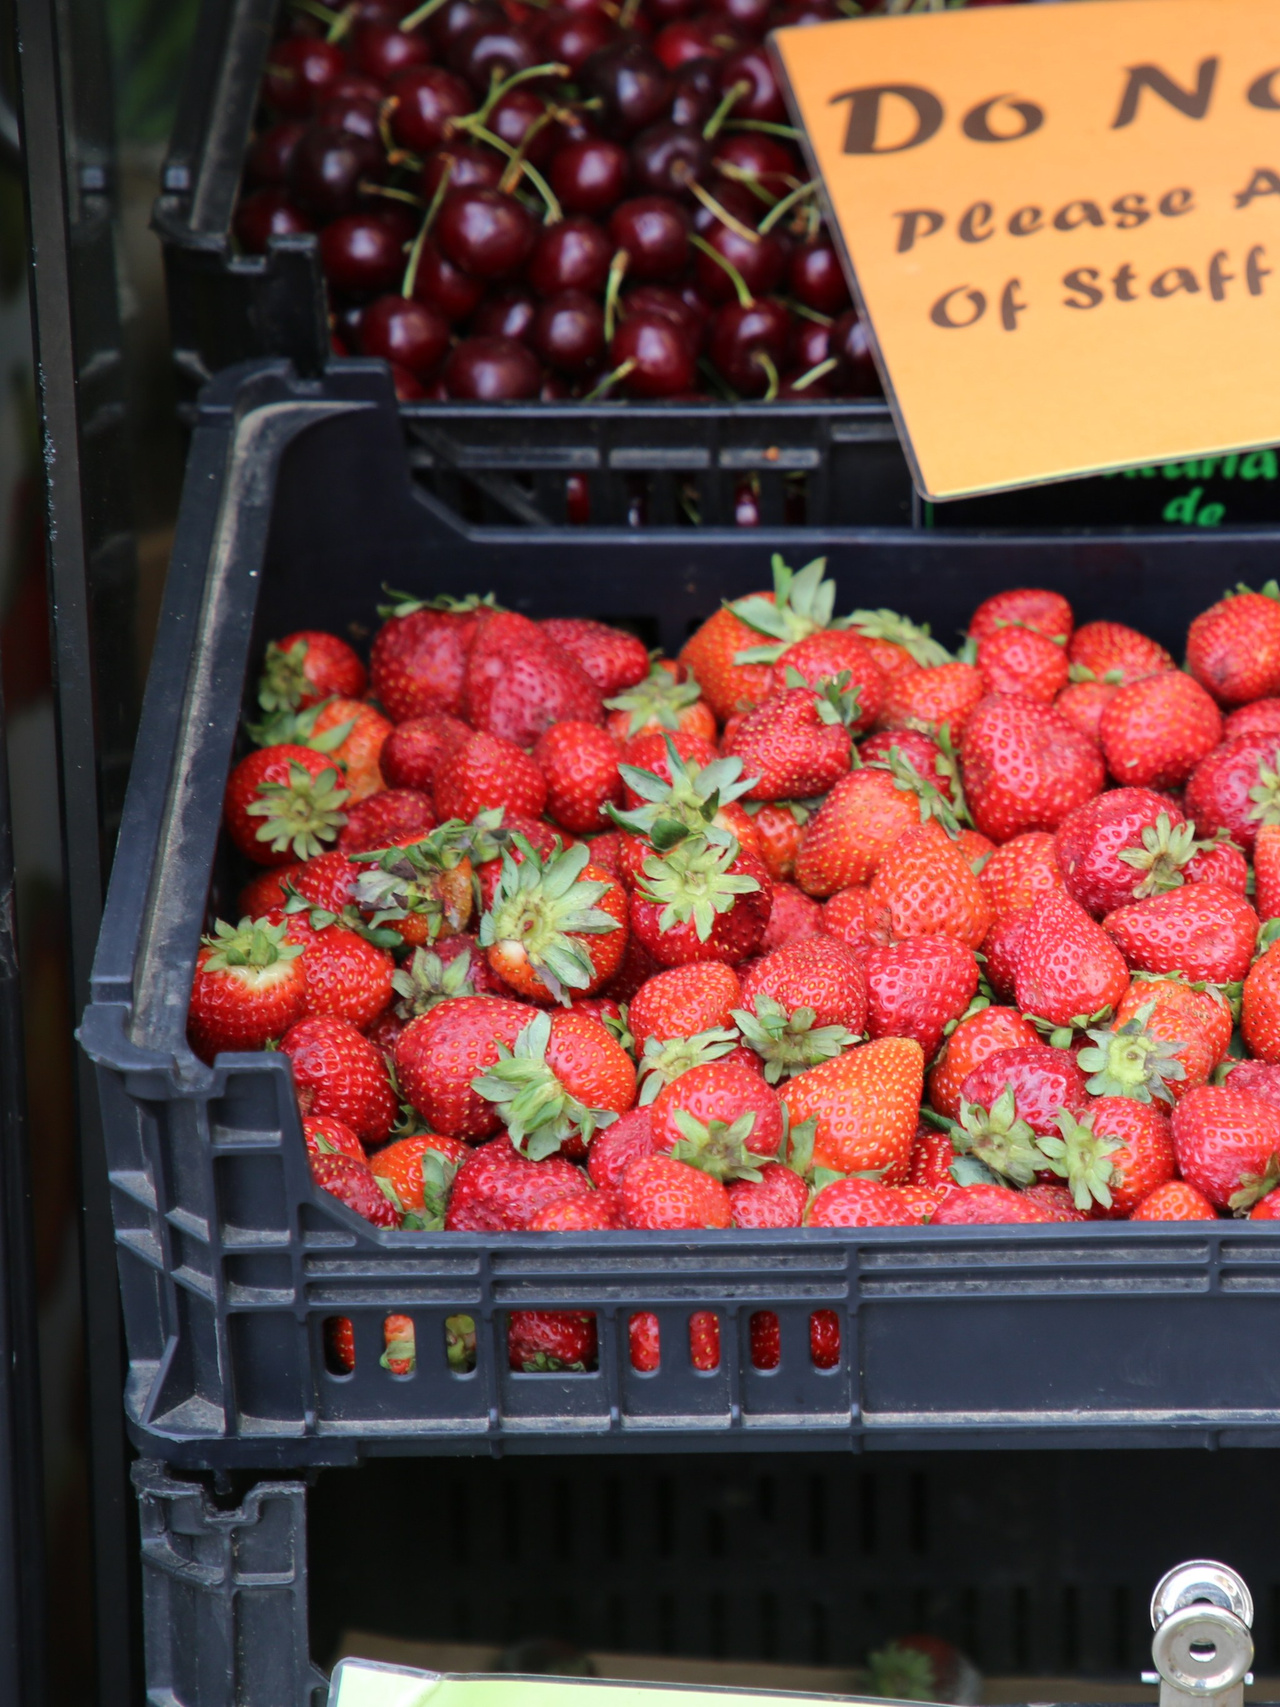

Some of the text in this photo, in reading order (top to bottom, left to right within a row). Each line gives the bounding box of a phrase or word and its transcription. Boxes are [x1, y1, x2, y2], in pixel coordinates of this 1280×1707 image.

[827, 81, 1047, 156] Do
[893, 187, 1196, 254] Please
[929, 278, 1029, 332] Of
[1060, 245, 1274, 310] Staff
[1162, 486, 1227, 527] de
